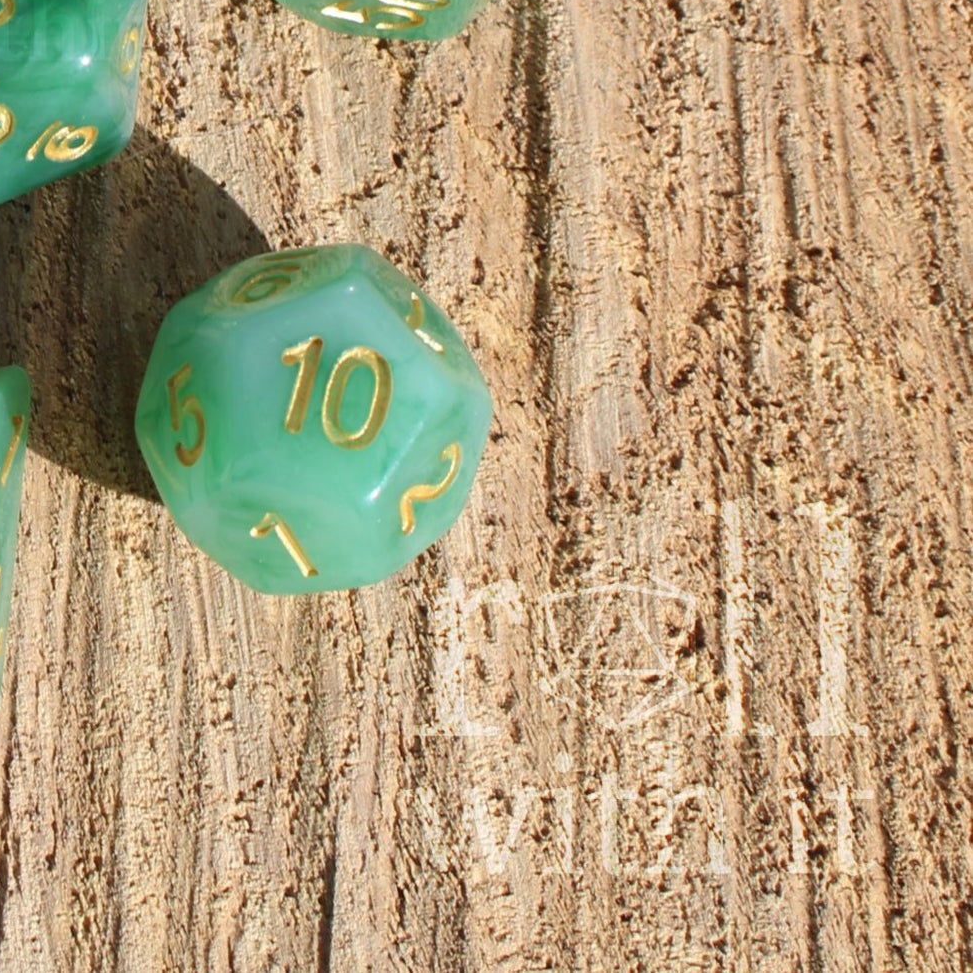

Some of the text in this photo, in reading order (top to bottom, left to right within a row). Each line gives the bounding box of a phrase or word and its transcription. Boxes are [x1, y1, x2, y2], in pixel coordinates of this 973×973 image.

[166, 363, 205, 467] 5
[281, 335, 394, 450] 10
[399, 442, 461, 535] 2
